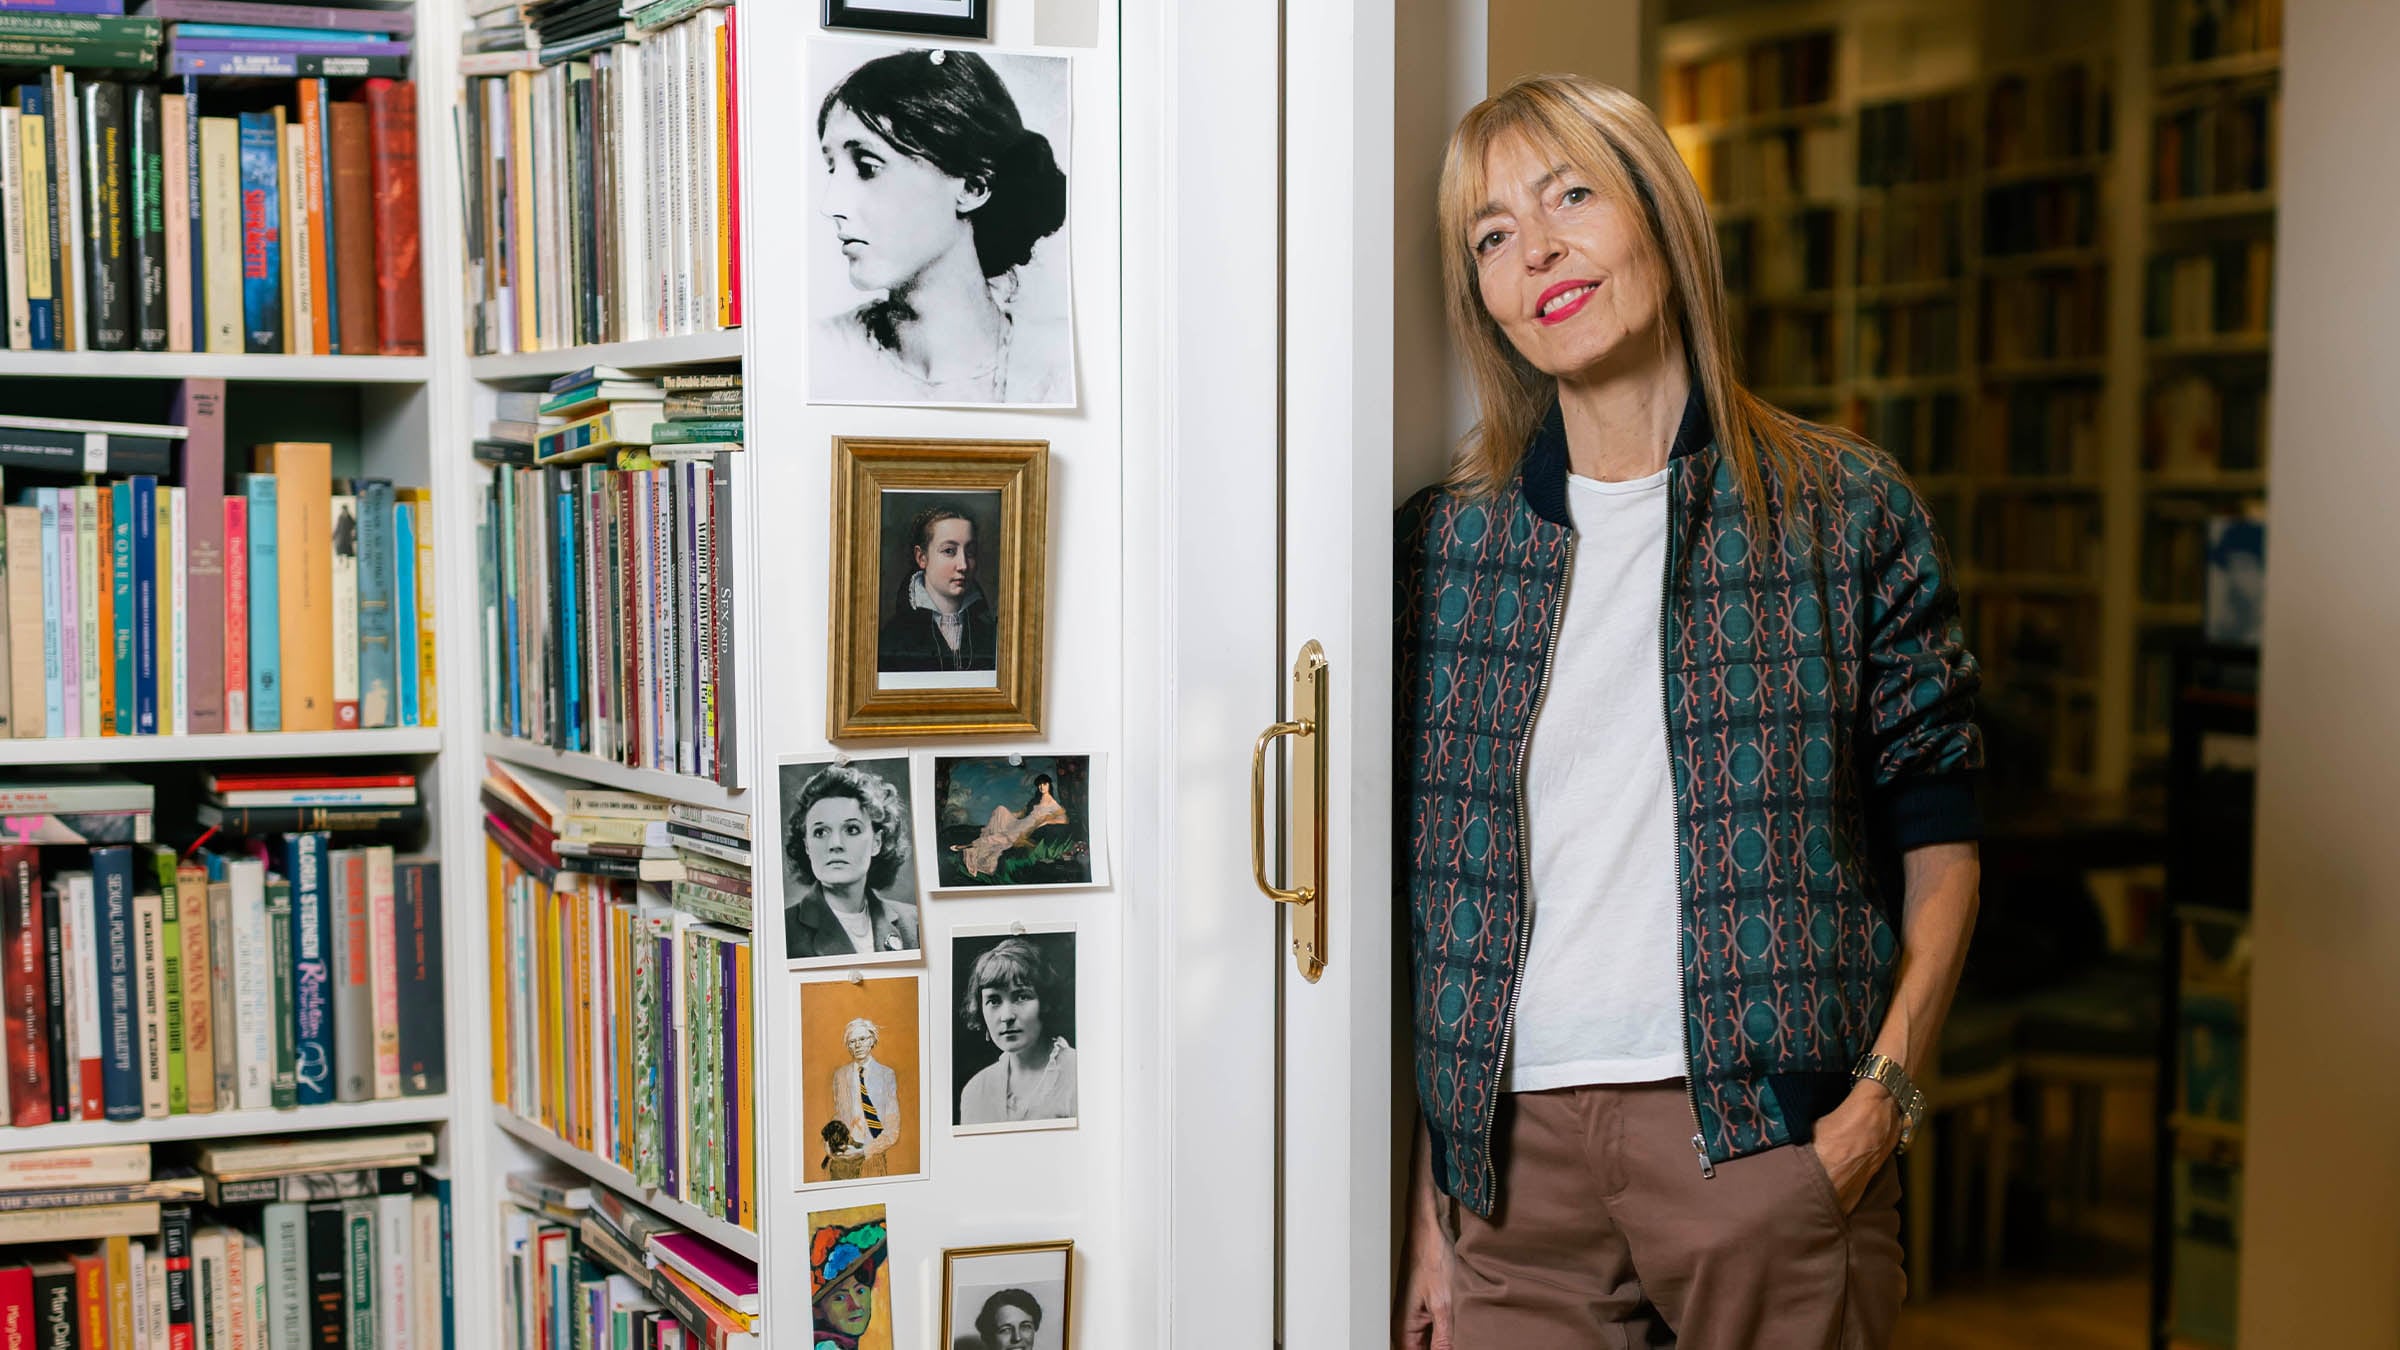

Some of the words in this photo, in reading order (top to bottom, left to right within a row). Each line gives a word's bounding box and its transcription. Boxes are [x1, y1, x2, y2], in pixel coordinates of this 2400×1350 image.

[244, 189, 267, 280] SUFFRAGETTE
[663, 376, 676, 387] The
[676, 376, 700, 387] Double
[700, 375, 734, 388] Standard
[622, 489, 631, 600] HIPPARCHIA'S
[661, 511, 669, 603] Feminism
[698, 522, 707, 581] Women,
[720, 586, 732, 621] SEX
[663, 627, 671, 713] Bioethics
[298, 834, 319, 892] GLORIA
[18, 861, 30, 928] GERMAINE
[107, 873, 122, 920] SEXUAL
[186, 896, 203, 919] OF
[22, 931, 34, 973] GREER
[110, 920, 126, 973] POLITICS
[300, 893, 320, 959] STEINEM
[187, 923, 206, 994] WOMAN
[111, 975, 127, 1009] KATE
[113, 1012, 129, 1071] MILLETT
[191, 1000, 209, 1052] BORN
[48, 1286, 69, 1323] Mary
[169, 1271, 185, 1311] Death
